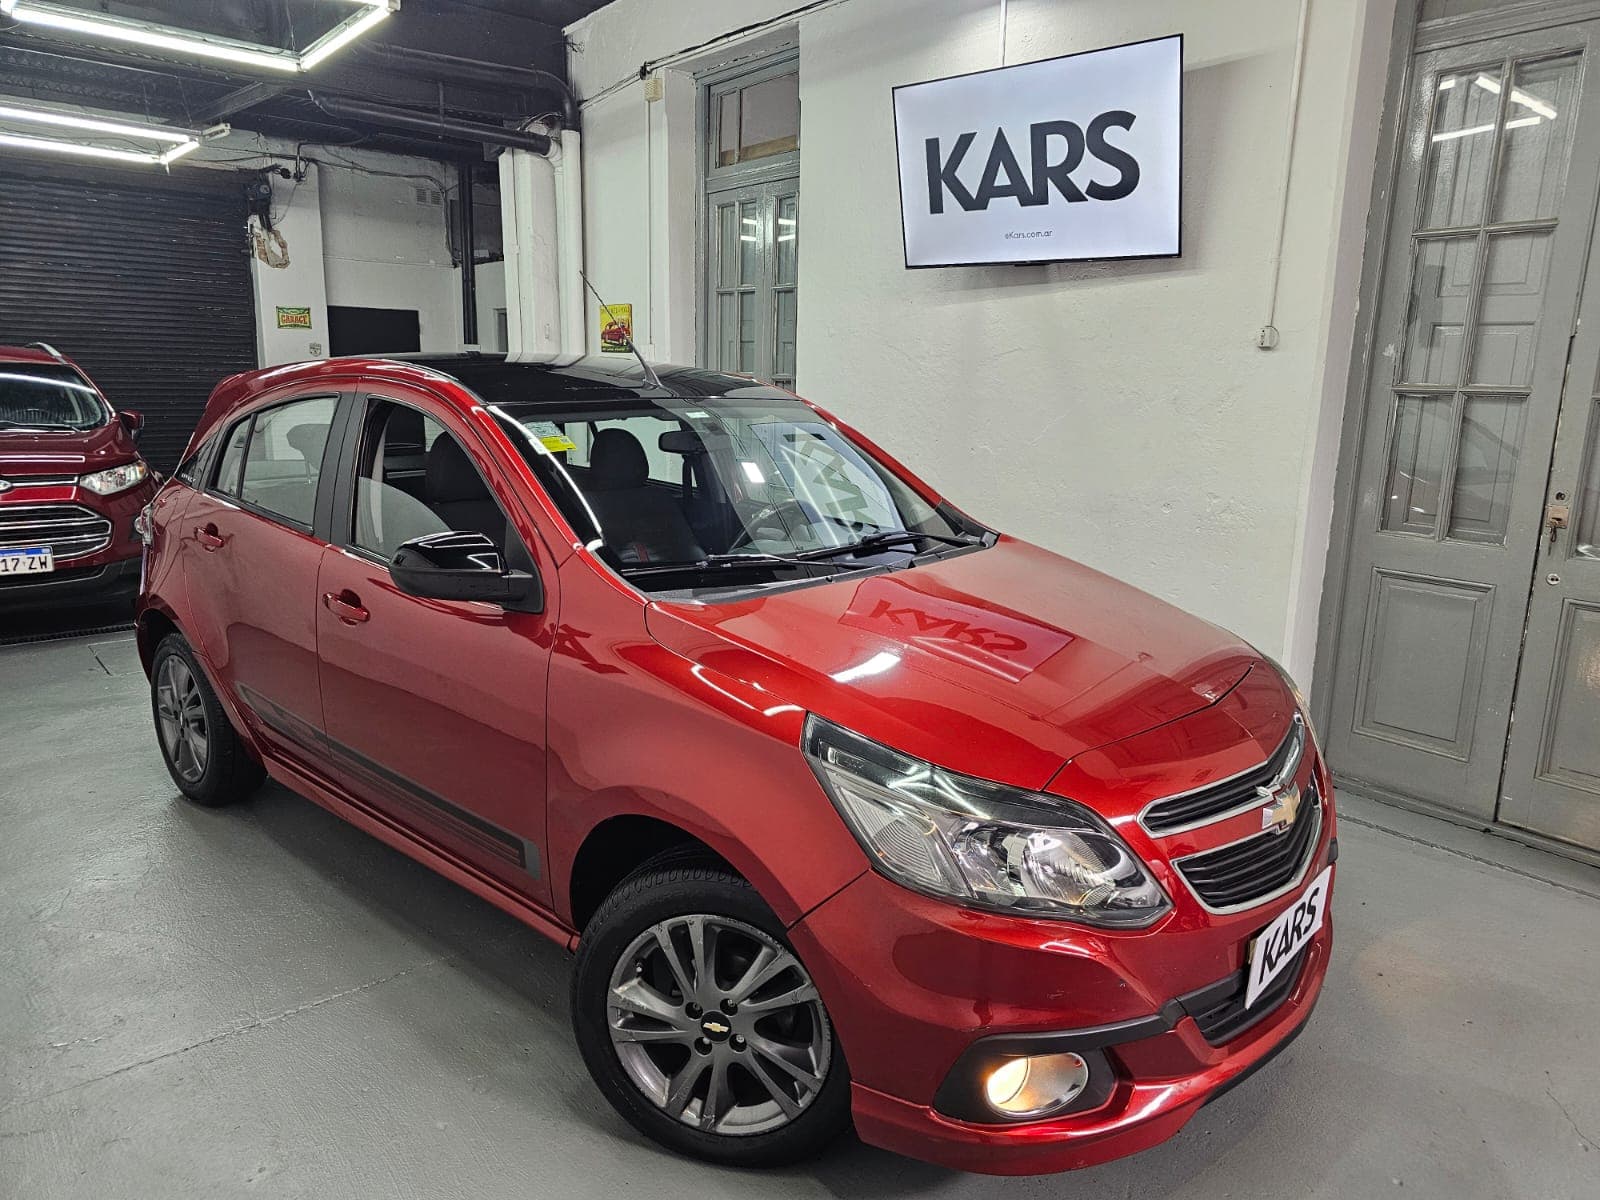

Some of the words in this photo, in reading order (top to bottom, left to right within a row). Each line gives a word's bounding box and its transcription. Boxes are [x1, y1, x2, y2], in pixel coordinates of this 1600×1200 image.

[925, 110, 1140, 214] KARS
[1004, 230, 1053, 239] eKars.com.ar
[0, 558, 20, 572] 17
[27, 556, 47, 570] ZW
[1258, 886, 1320, 985] KARS
